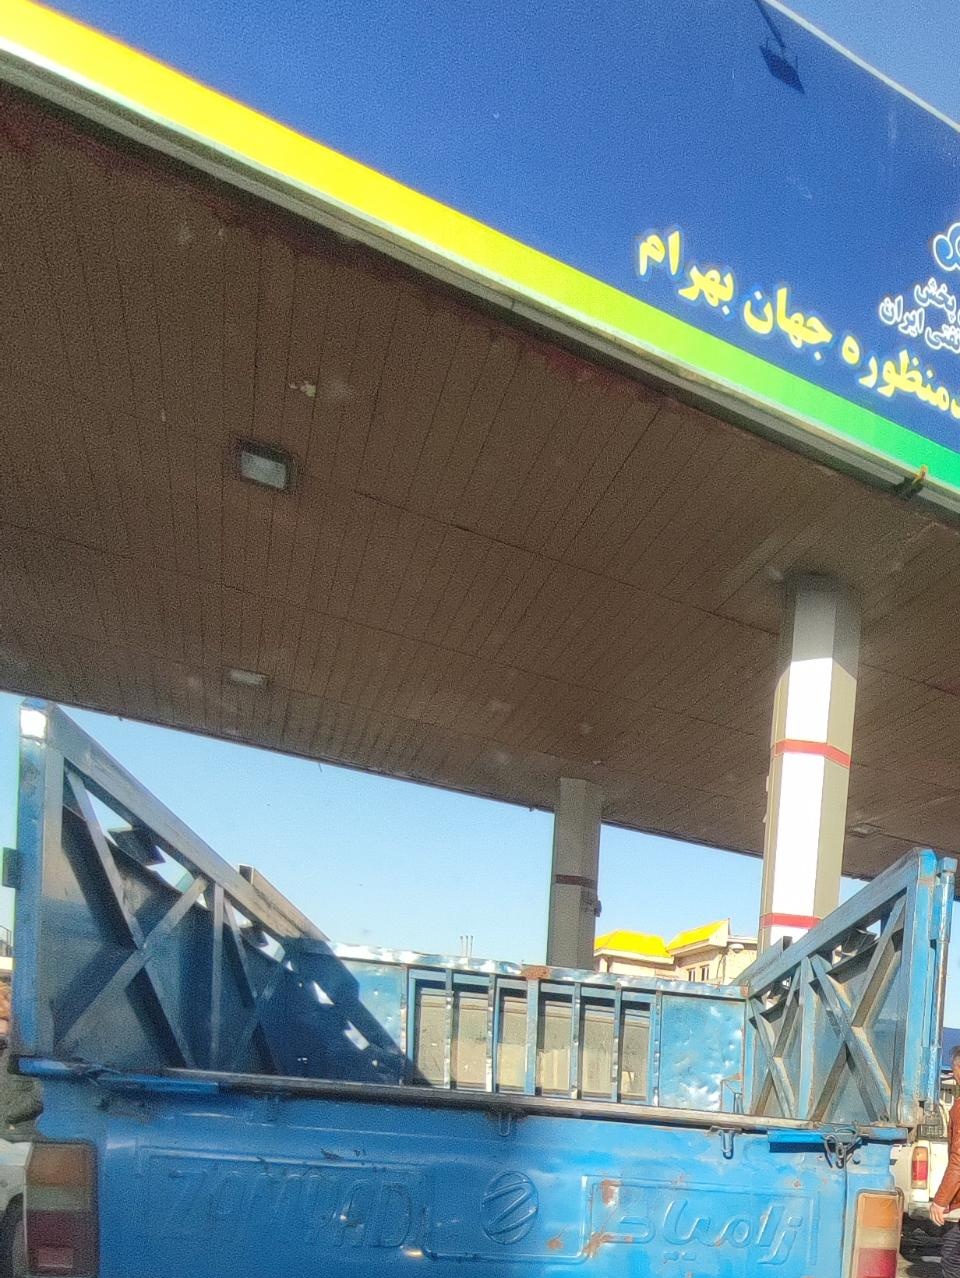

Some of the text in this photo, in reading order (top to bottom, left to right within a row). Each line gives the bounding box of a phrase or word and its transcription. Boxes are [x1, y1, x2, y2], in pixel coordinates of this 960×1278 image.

[638, 230, 735, 316] بهرام
[914, 277, 957, 324] پخش
[742, 286, 833, 361] جهان
[879, 295, 925, 337] ایران
[598, 1198, 805, 1267] زامیاد
